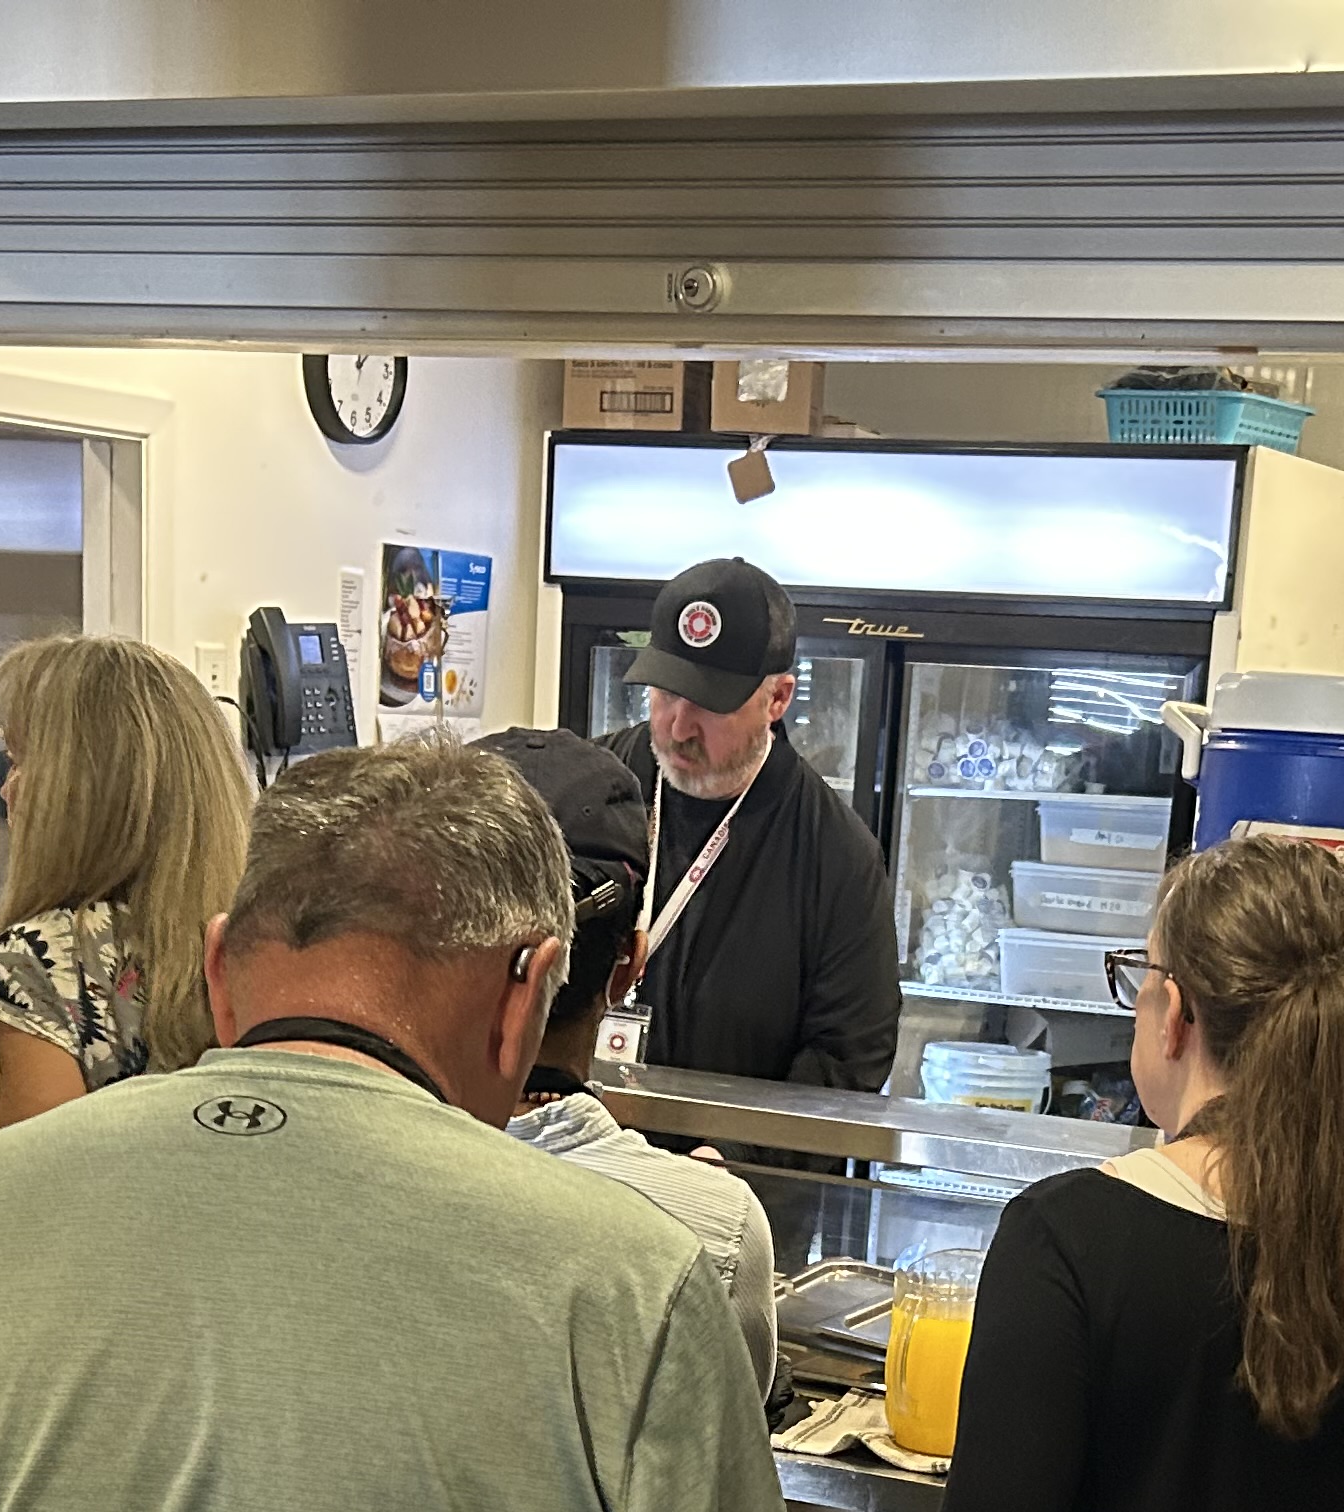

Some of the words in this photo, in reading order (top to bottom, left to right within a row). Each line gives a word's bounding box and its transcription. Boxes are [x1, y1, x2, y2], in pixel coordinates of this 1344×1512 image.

[383, 363, 390, 379] 3
[377, 390, 383, 405] 4
[350, 410, 357, 427] 6
[365, 407, 371, 423] 5
[822, 618, 924, 638] true
